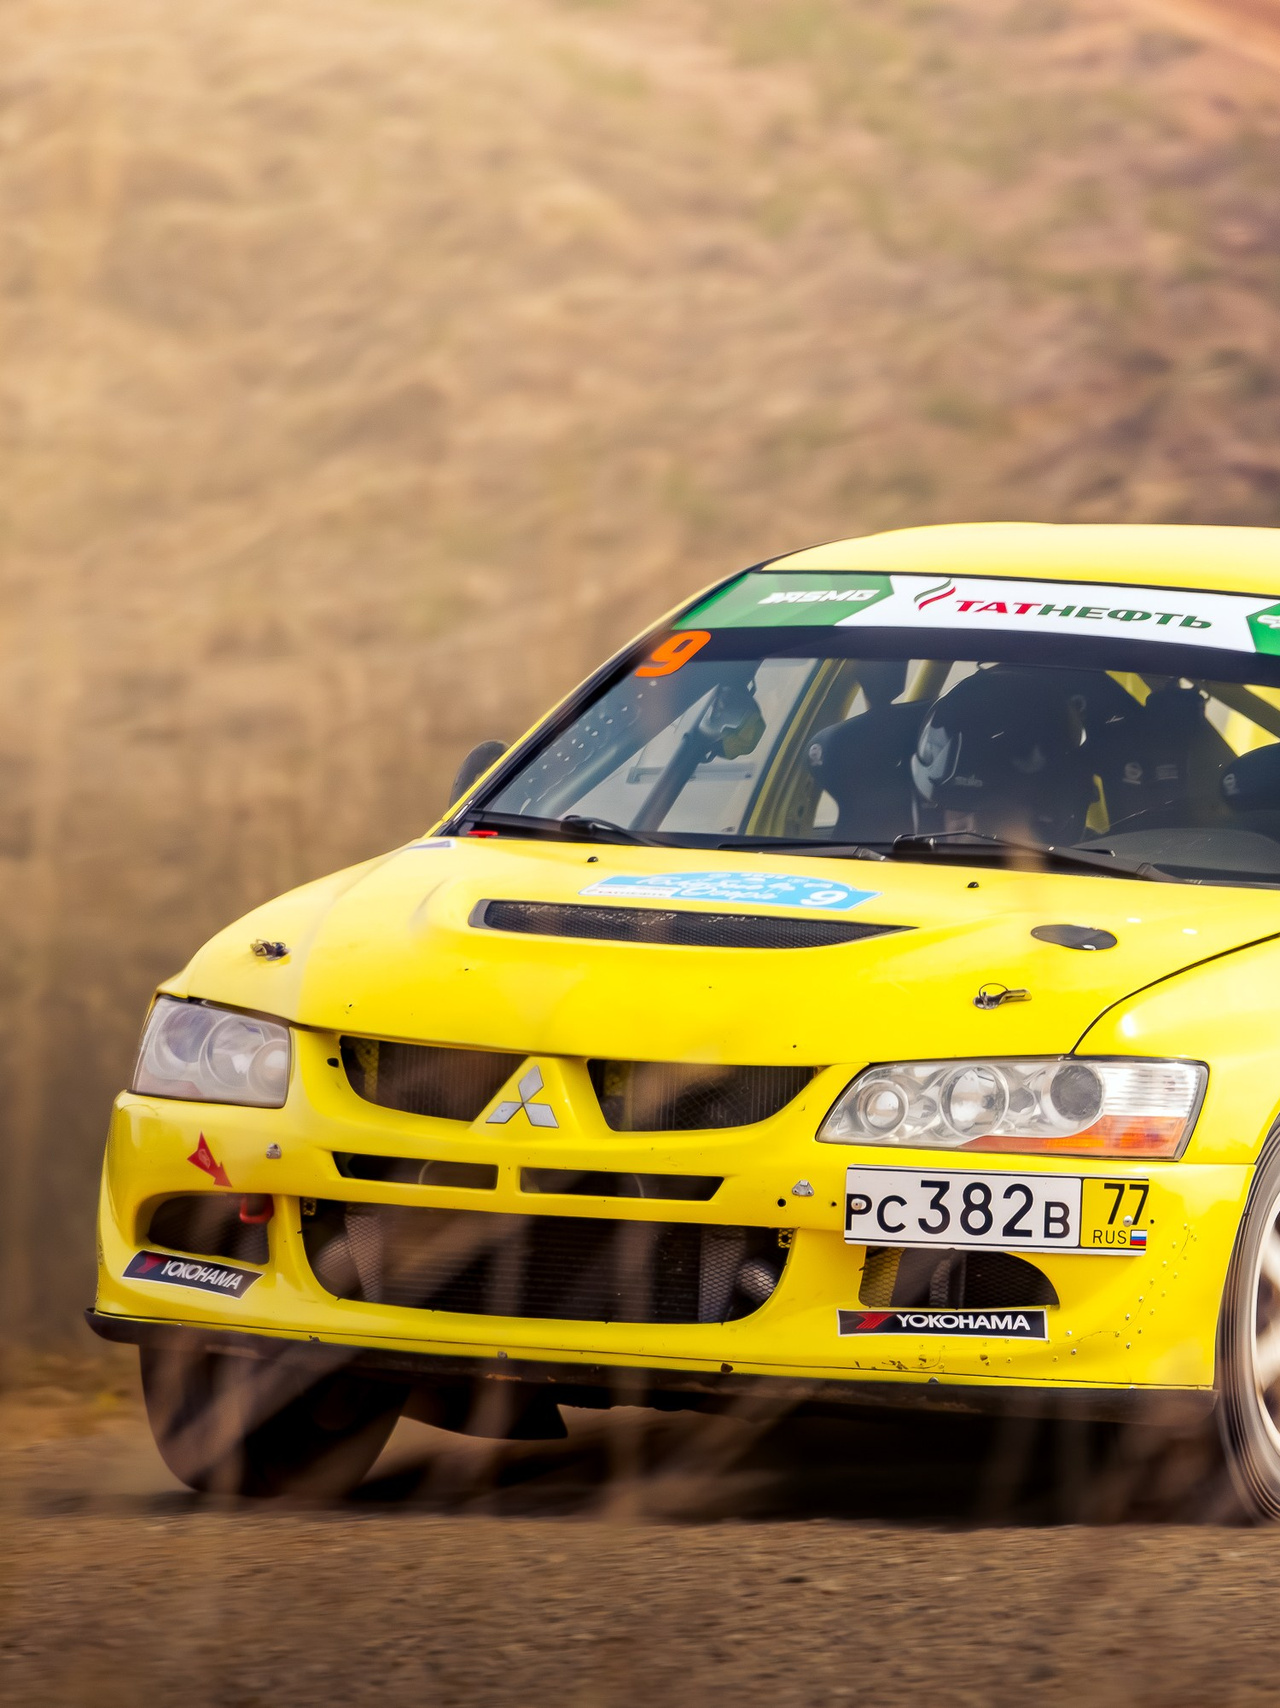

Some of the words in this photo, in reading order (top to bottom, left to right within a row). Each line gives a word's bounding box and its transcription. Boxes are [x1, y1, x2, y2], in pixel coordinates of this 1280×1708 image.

[956, 600, 1212, 629] ТАТНЕФТЬ
[635, 631, 712, 678] 9
[799, 890, 848, 906] 9
[1103, 1182, 1149, 1226] 77
[1093, 1229, 1127, 1245] RUS
[161, 1260, 244, 1290] YOKOHAMA
[896, 1313, 1031, 1331] YOKOHAMA
